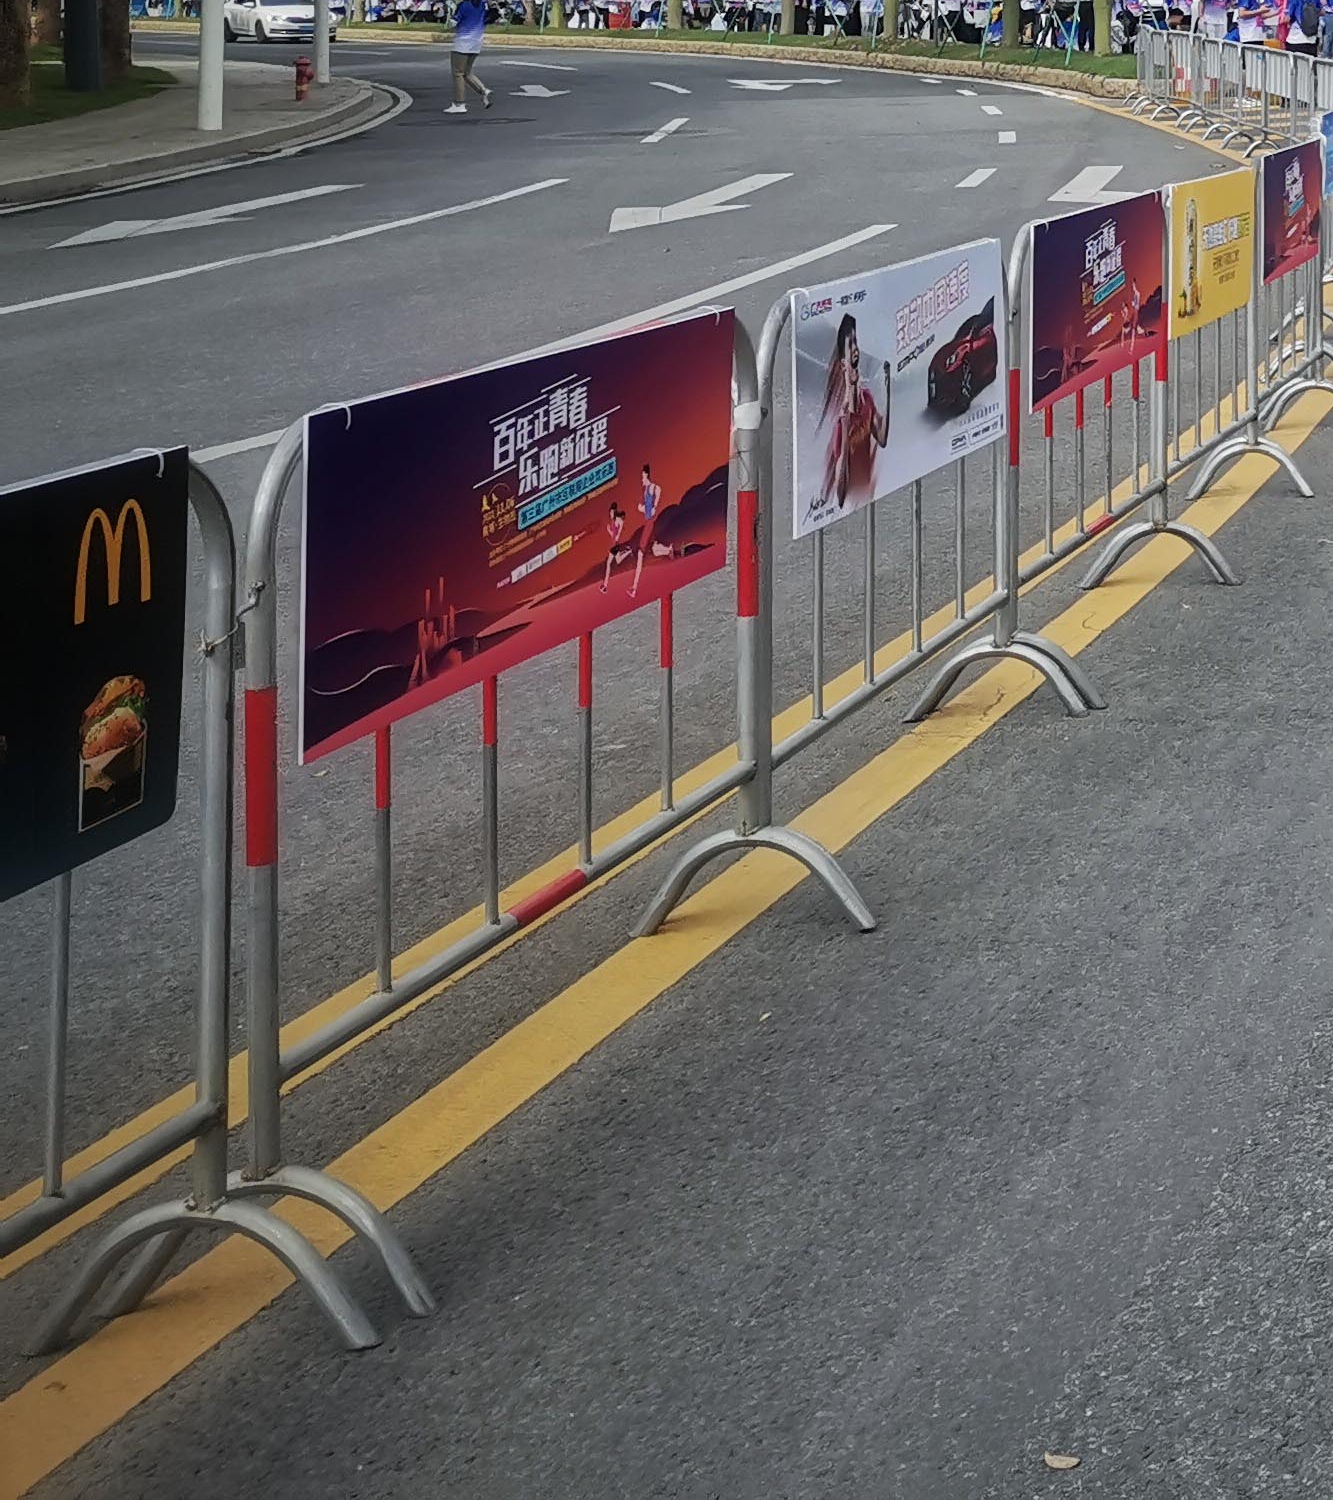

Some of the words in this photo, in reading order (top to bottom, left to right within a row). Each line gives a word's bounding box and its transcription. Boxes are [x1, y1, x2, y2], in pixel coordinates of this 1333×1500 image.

[493, 386, 588, 470] 百年正青春
[518, 416, 608, 496] 乐跑新征程
